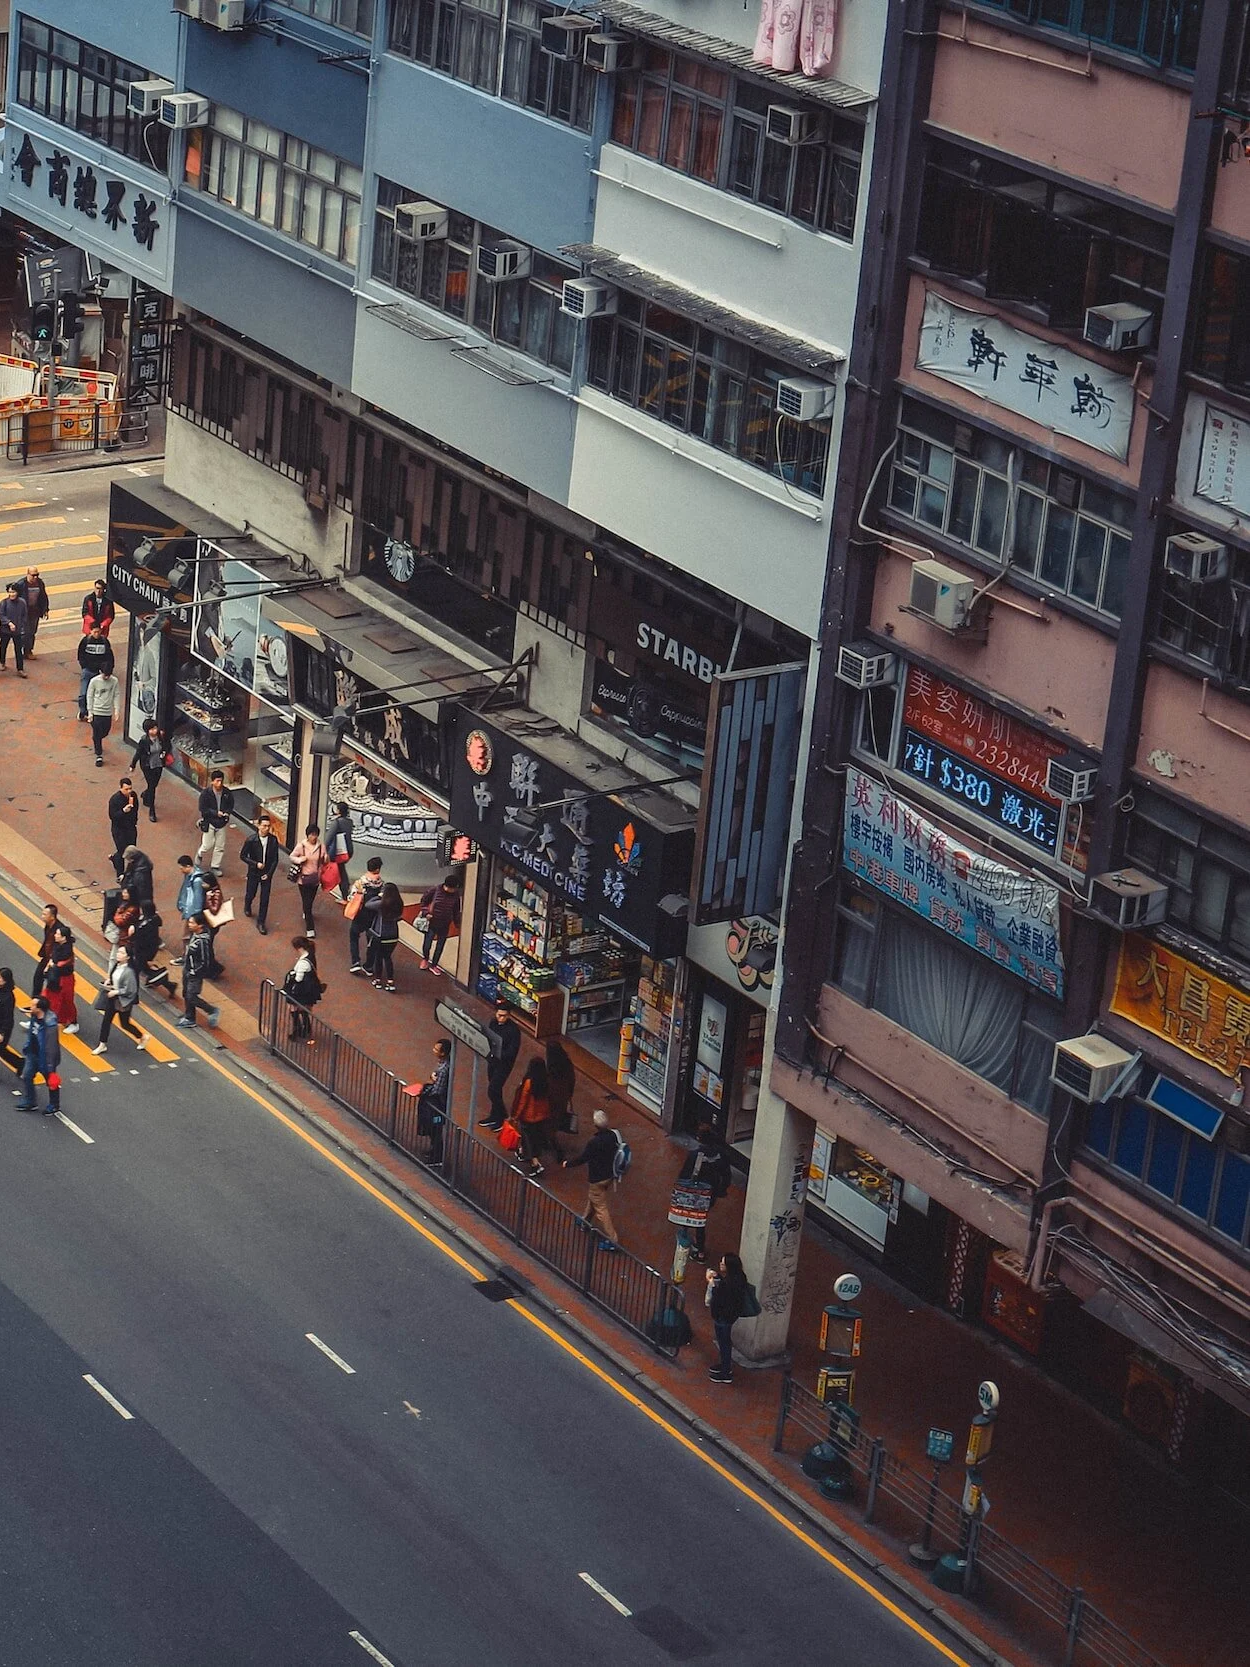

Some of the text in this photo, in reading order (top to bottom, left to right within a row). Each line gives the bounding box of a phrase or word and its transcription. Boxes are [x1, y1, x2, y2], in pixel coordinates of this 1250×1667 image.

[111, 563, 132, 587] CITY
[133, 577, 160, 606] CHAIN
[660, 704, 707, 731] Cappuccin
[939, 757, 992, 807] $380
[975, 738, 1056, 799] 2328444
